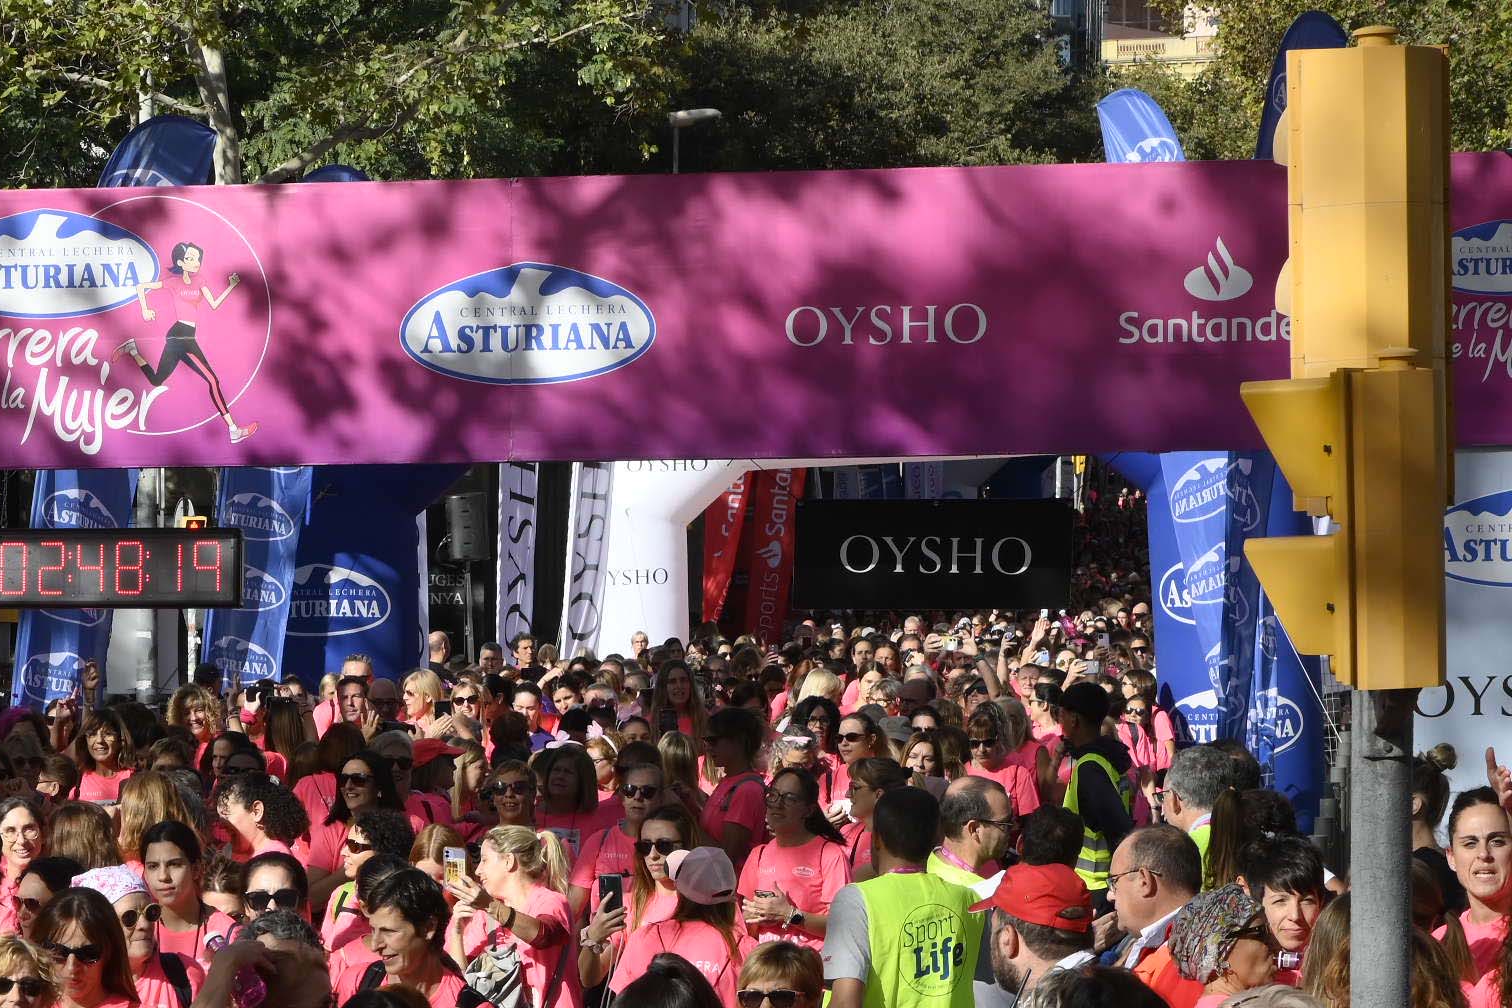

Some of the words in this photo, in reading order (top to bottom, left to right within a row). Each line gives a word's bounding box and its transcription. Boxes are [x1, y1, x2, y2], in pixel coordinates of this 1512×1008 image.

[61, 245, 137, 258] LECHERA
[459, 304, 540, 319] CENTRAL
[545, 302, 627, 317] LECHERA
[785, 303, 988, 346] OYSHO
[420, 310, 636, 354] ASTURIANA
[1469, 331, 1486, 358] la
[20, 360, 168, 455] Mujer
[839, 534, 1034, 576] OYSHO
[327, 588, 377, 598] LECHERA
[903, 914, 956, 949] Sport
[914, 936, 964, 981] Life
